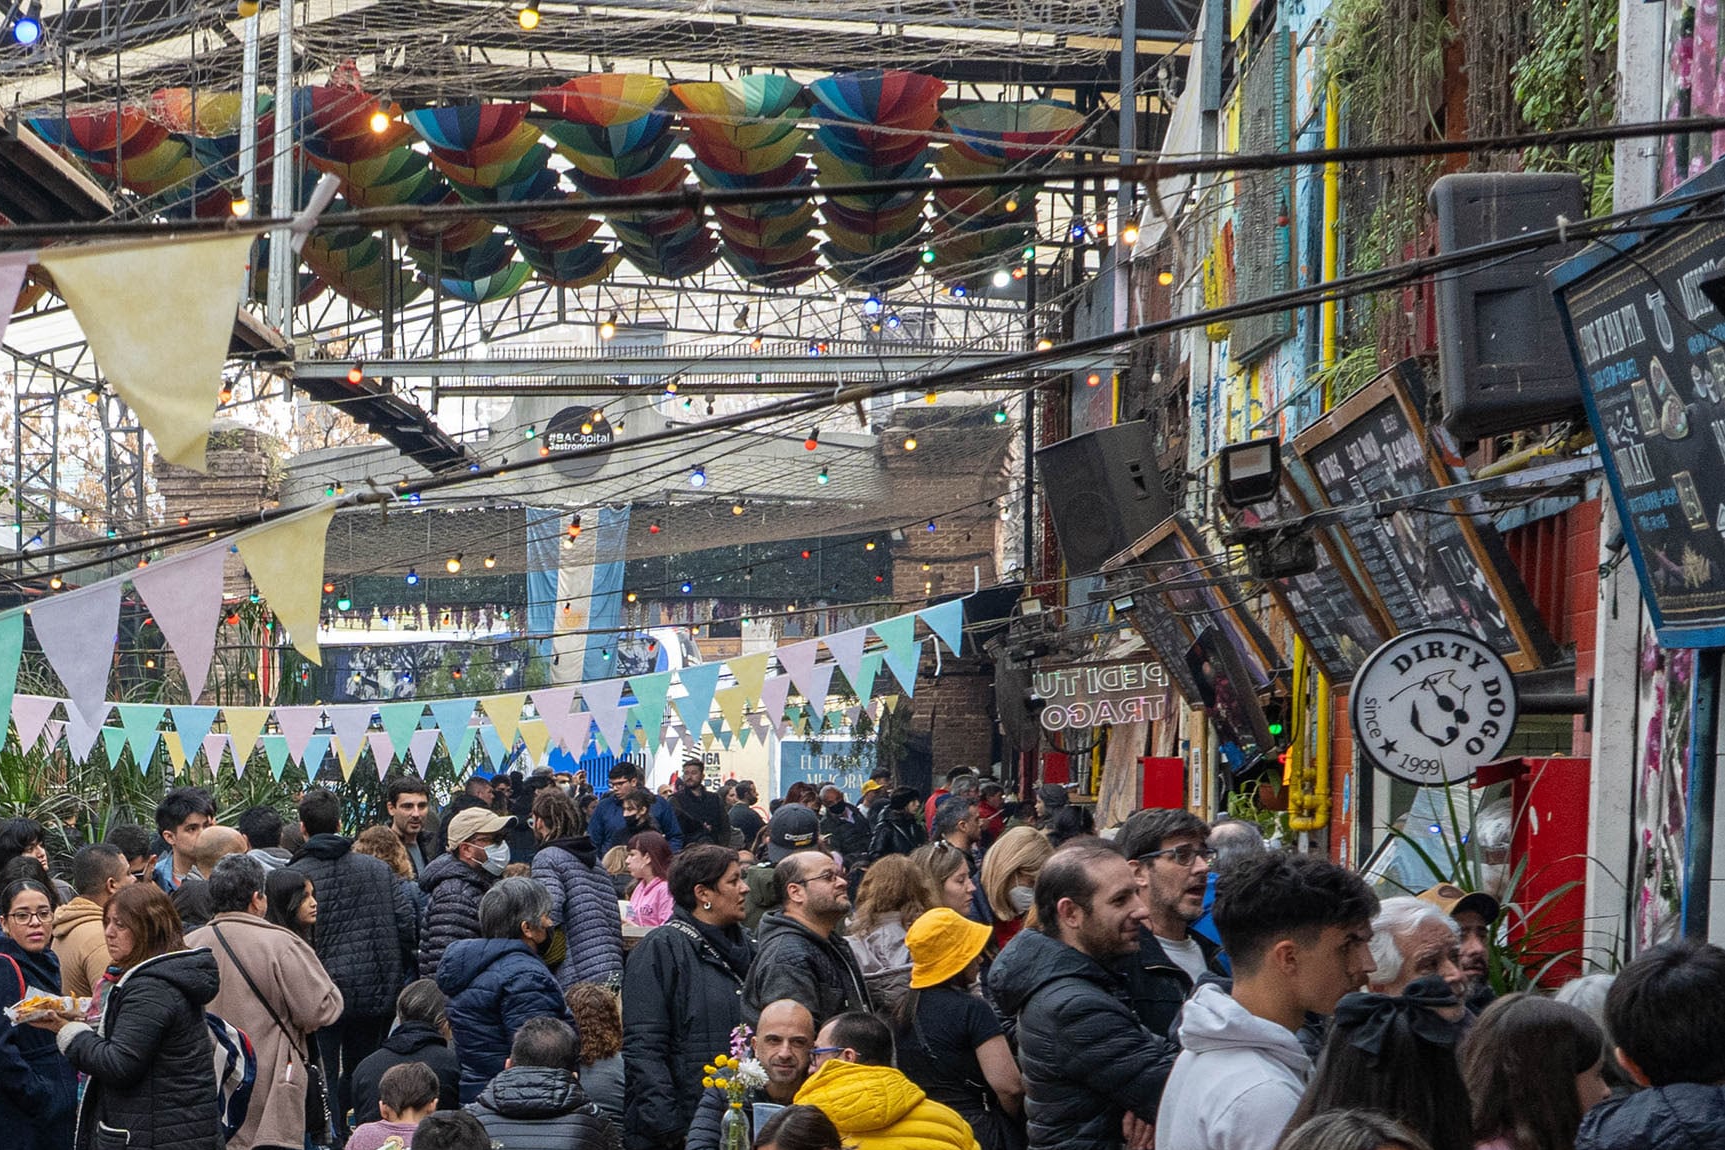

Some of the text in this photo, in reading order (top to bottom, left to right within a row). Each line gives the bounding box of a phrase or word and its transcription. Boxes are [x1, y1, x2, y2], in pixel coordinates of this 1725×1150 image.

[1390, 640, 1490, 676] DIRTY
[1465, 676, 1506, 756] DOGO
[1363, 696, 1382, 739] since
[800, 755, 813, 770] EL
[1397, 753, 1440, 776] 1999
